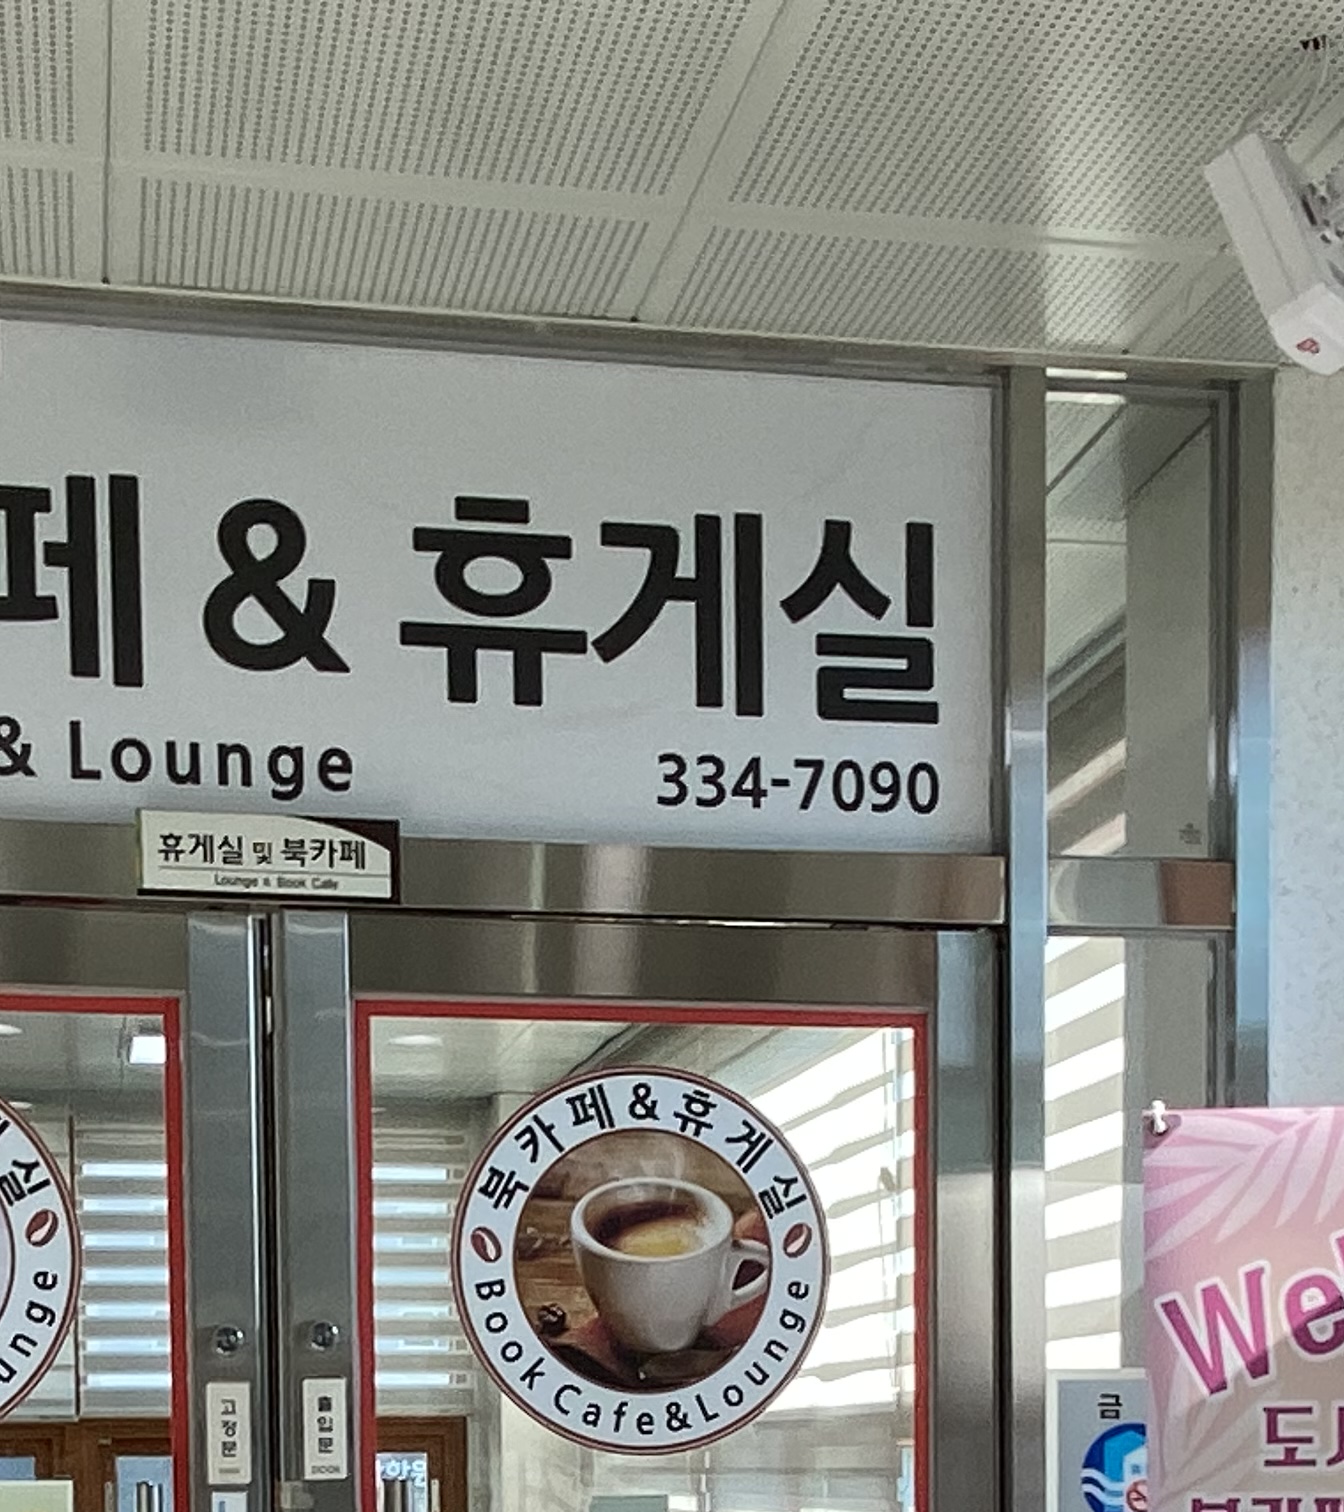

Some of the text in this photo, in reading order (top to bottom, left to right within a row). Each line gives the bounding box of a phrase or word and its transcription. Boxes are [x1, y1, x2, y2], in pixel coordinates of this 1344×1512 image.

[202, 498, 351, 674] &
[399, 495, 940, 725] 휴게실
[68, 720, 353, 802] Lounge
[656, 752, 940, 815] 334-7090
[157, 832, 366, 871] 휴게실 및 북카페
[474, 1278, 547, 1391] Book
[220, 1398, 238, 1458] 고정문
